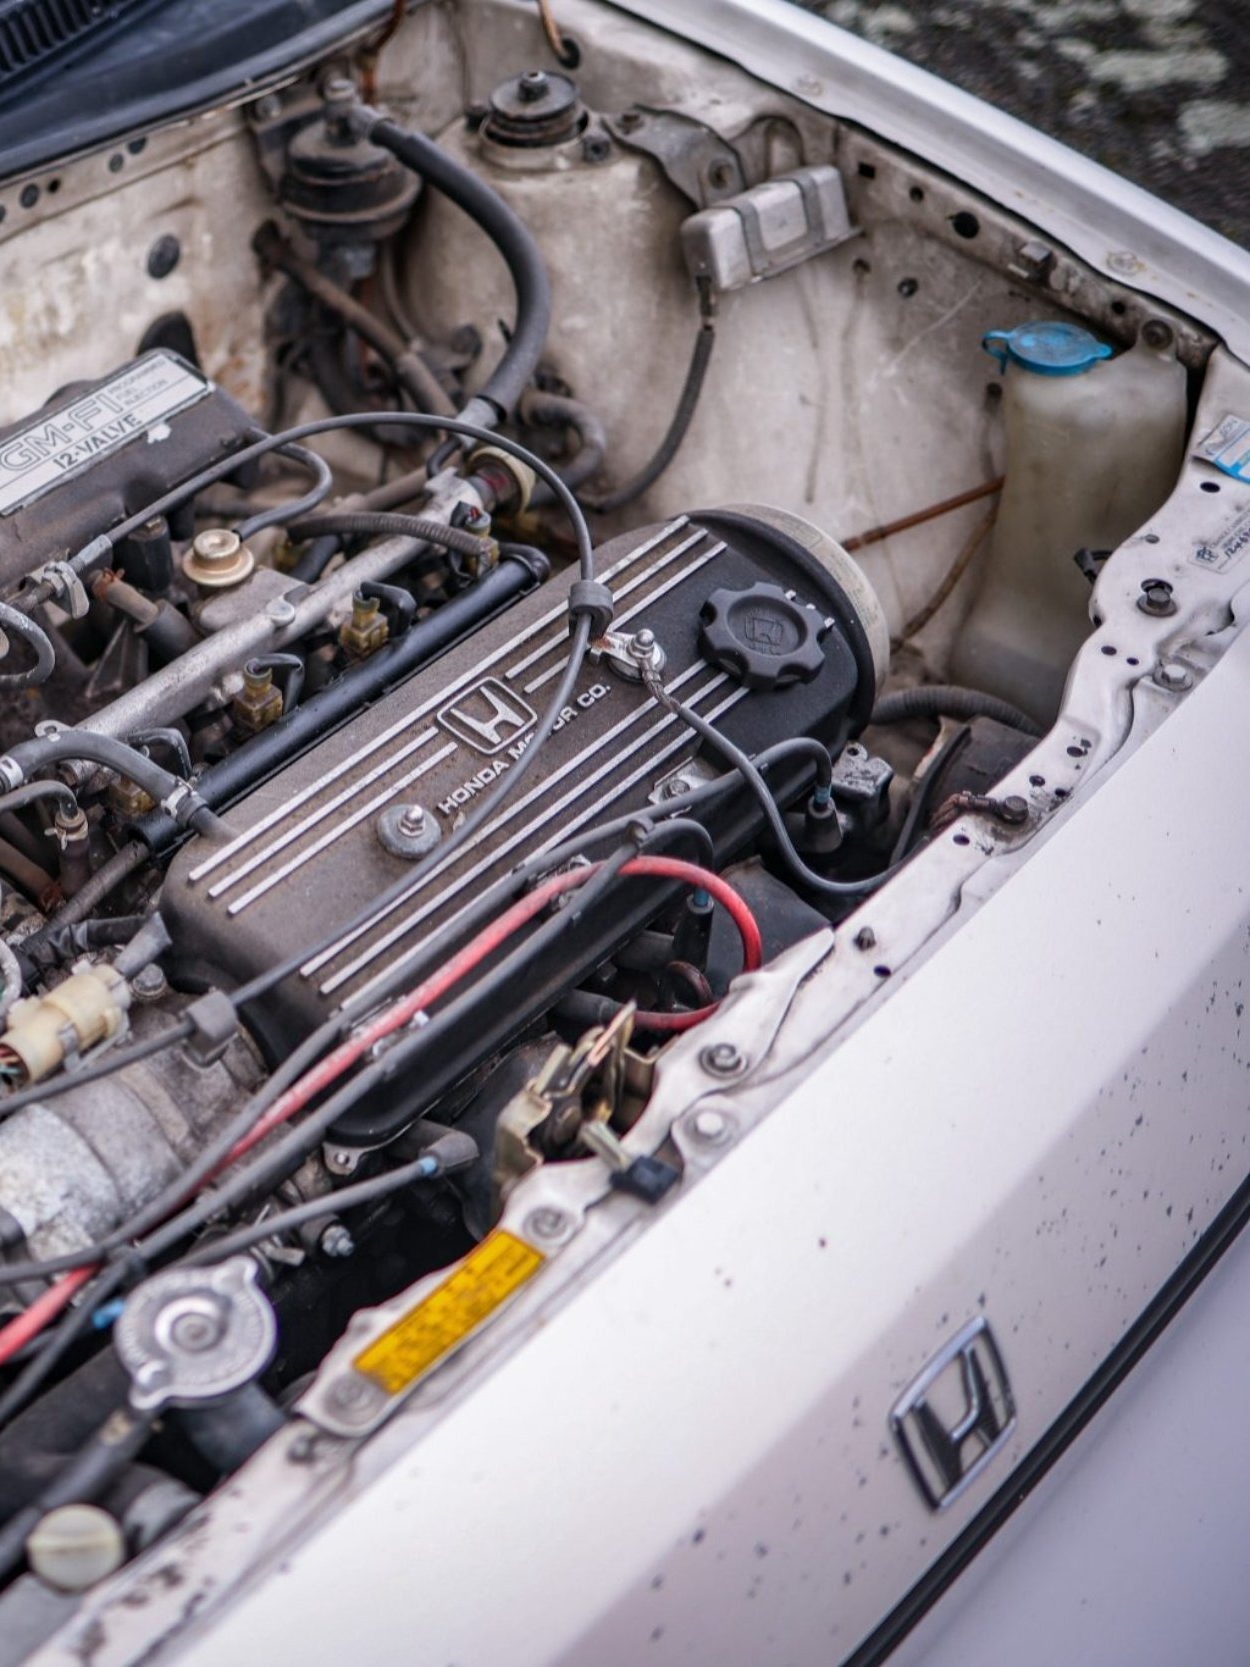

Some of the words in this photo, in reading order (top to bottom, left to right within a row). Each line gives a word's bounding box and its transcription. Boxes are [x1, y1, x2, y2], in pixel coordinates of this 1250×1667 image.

[53, 413, 142, 470] 12-VALVE
[438, 760, 510, 815] HONDA
[507, 705, 578, 761] MOR
[576, 683, 611, 708] CO.
